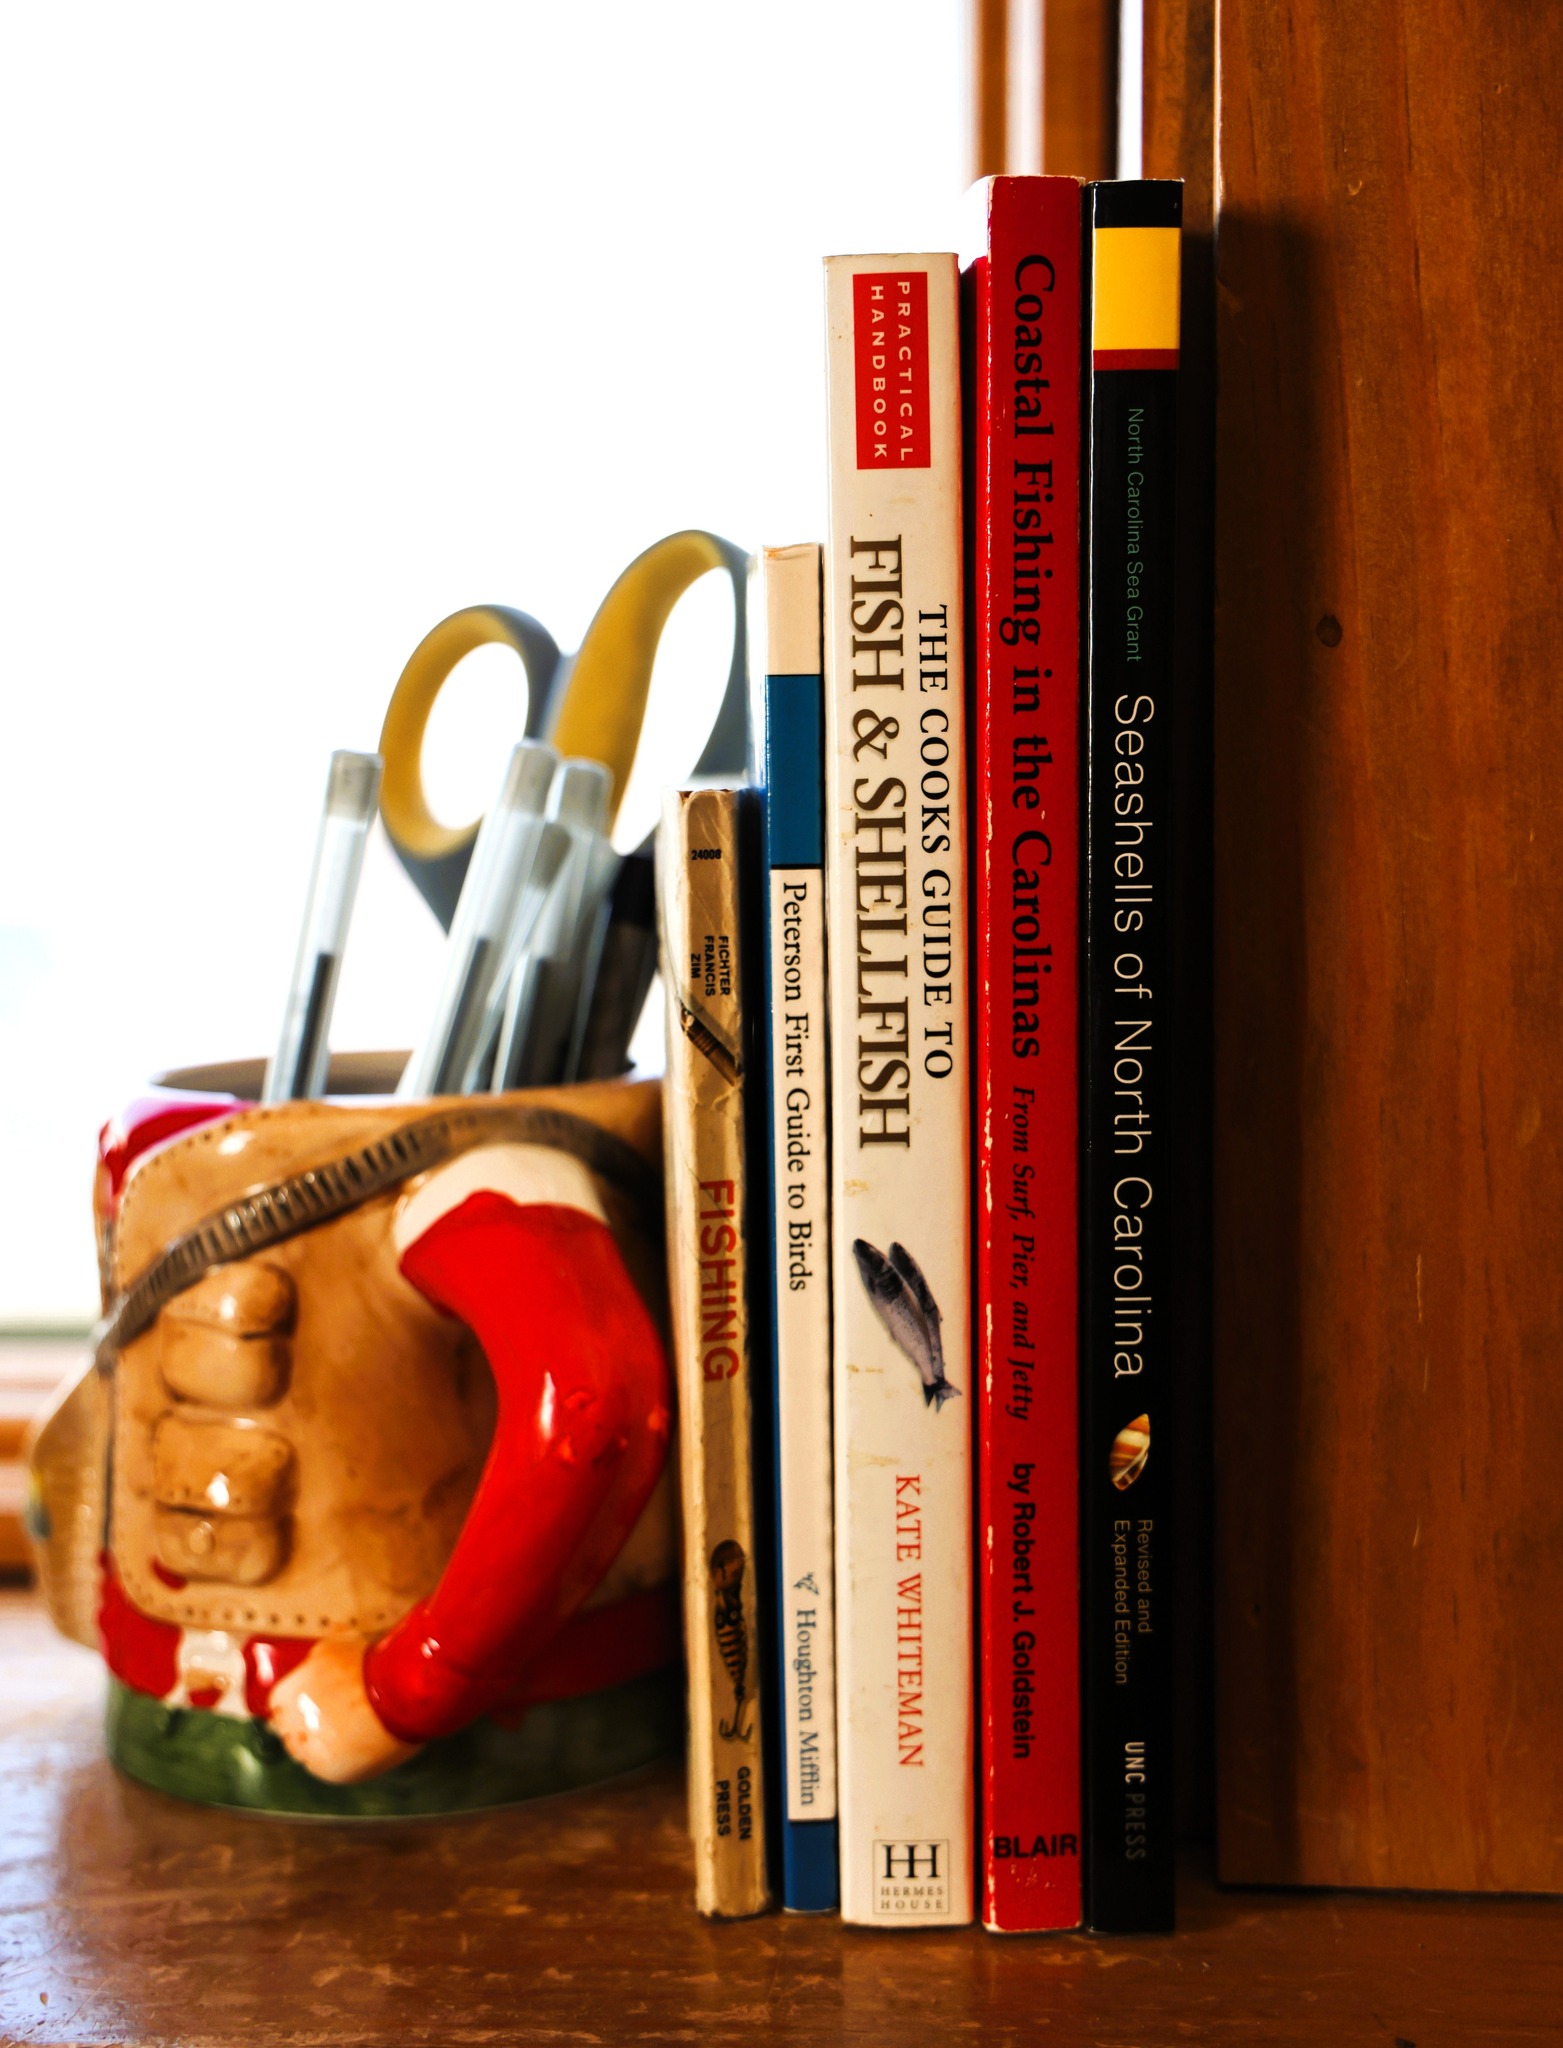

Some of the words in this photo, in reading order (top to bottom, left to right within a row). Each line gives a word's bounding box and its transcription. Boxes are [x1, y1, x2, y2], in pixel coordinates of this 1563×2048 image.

[871, 285, 888, 458] HANDBOOK
[898, 281, 914, 461] PRACTICAL
[1013, 254, 1055, 439] Coastal
[1127, 408, 1145, 464] North
[1127, 471, 1145, 555] Carolina
[999, 459, 1054, 646] Fishing
[1126, 561, 1144, 599] Sea
[850, 534, 905, 692] FISH
[1126, 606, 1144, 662] Grant
[919, 604, 949, 693] THE
[1013, 665, 1053, 715] in
[852, 708, 900, 763] &
[920, 708, 950, 854] COOKS
[1012, 734, 1053, 809] the
[1114, 694, 1155, 933] Seashells
[691, 848, 722, 861] 24008
[691, 953, 701, 979] ZIM
[704, 935, 716, 997] FRANCIS
[718, 935, 731, 996] FICHTER
[783, 882, 807, 1002] Peterson
[853, 777, 911, 1150] SHELLFISH
[922, 869, 952, 1007] GUIDE
[1011, 830, 1052, 1060] Carolinas
[1114, 953, 1153, 999] of
[785, 1013, 809, 1077] First
[924, 1021, 953, 1079] TO
[1012, 1085, 1036, 1153] From
[1114, 1020, 1153, 1154] North
[786, 1088, 811, 1172] Guide
[788, 1183, 806, 1209] to
[1006, 1163, 1036, 1222] Surf,
[700, 1179, 740, 1382] FISHING
[789, 1220, 813, 1291] Birds
[1009, 1233, 1035, 1290] Pier,
[1113, 1176, 1153, 1379] Carolina
[1012, 1300, 1035, 1349] and
[1005, 1357, 1035, 1422] Jetty
[1008, 1463, 1036, 1494] by
[896, 1474, 922, 1562] KATE
[1012, 1502, 1036, 1594] Robert
[1111, 1520, 1130, 1613] Expanded
[1137, 1519, 1153, 1593] Revised
[1012, 1601, 1035, 1623] J.
[1138, 1599, 1153, 1633] and
[793, 1609, 817, 1722] Houghton
[897, 1573, 923, 1767] WHITEMAN
[1115, 1620, 1131, 1684] Edition
[1012, 1630, 1036, 1760] Goldstein
[799, 1731, 820, 1806] Mifflin
[1124, 1741, 1146, 1783] UNC
[716, 1780, 731, 1836] PRESS
[737, 1766, 752, 1840] GOLDEN
[1125, 1793, 1146, 1859] PRESS
[993, 1833, 1078, 1858] BLAIR
[881, 1886, 943, 1896] HERMES
[881, 1899, 942, 1910] HOUSE
